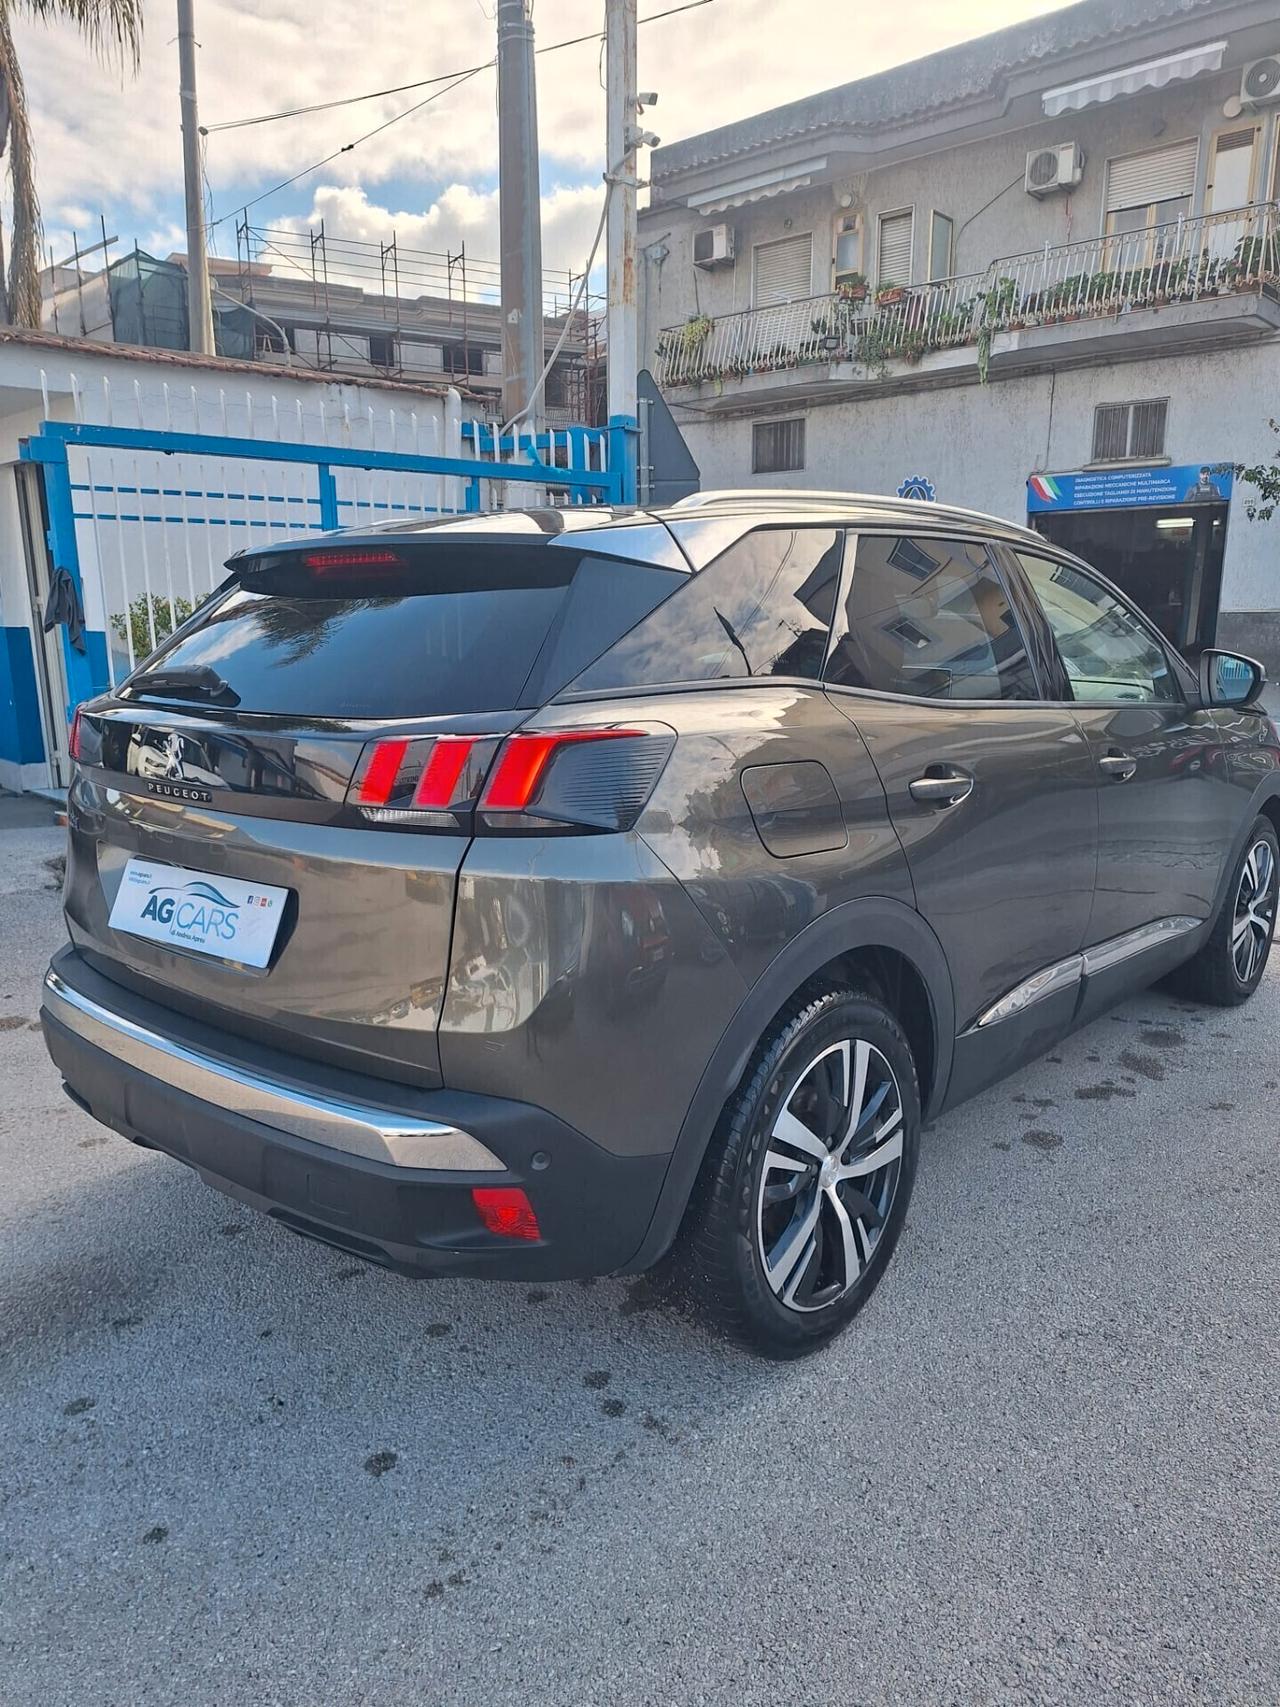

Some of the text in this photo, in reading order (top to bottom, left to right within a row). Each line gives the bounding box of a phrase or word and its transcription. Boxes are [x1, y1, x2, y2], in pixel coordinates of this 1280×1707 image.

[1108, 472, 1152, 480] COMPUTERIZZATA
[1104, 481, 1137, 489] MECCANICHE
[1136, 486, 1177, 494] MANUTENZIONE
[147, 782, 209, 801] PEUGEOT
[140, 895, 239, 940] AG CARS
